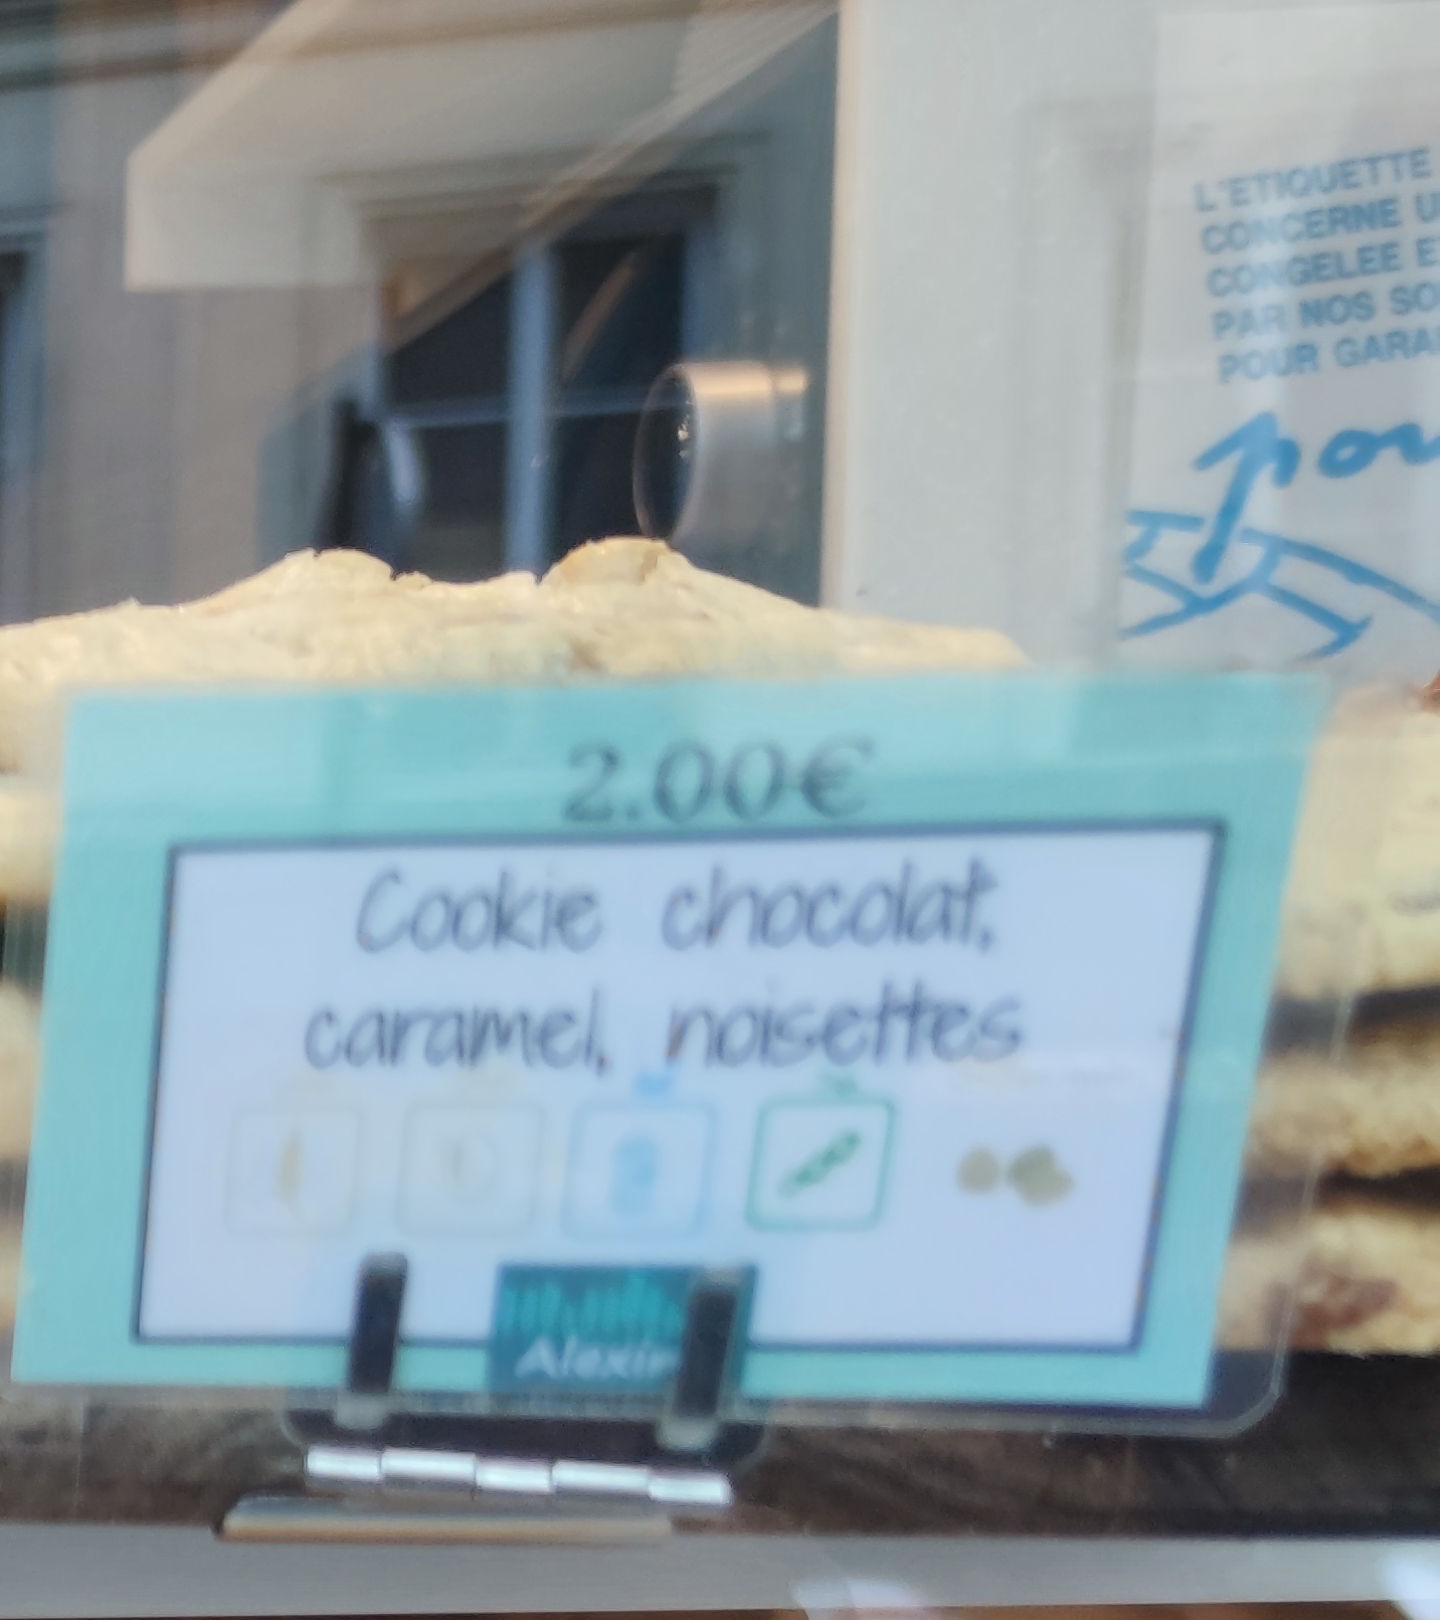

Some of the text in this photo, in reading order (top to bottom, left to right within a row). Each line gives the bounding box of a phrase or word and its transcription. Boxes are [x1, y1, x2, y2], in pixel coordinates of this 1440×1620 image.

[1192, 148, 1432, 212] L'ETIQUETTE
[1200, 198, 1403, 254] CONCERNE
[1206, 242, 1402, 297] CONGELEE
[1212, 303, 1286, 340] PAR
[1298, 291, 1376, 328] NOS
[1218, 326, 1440, 384] POUR GARA
[562, 734, 876, 825] 2.00€
[354, 852, 998, 956] Cookie chocolat,
[302, 980, 1027, 1077] caramel, noisettes
